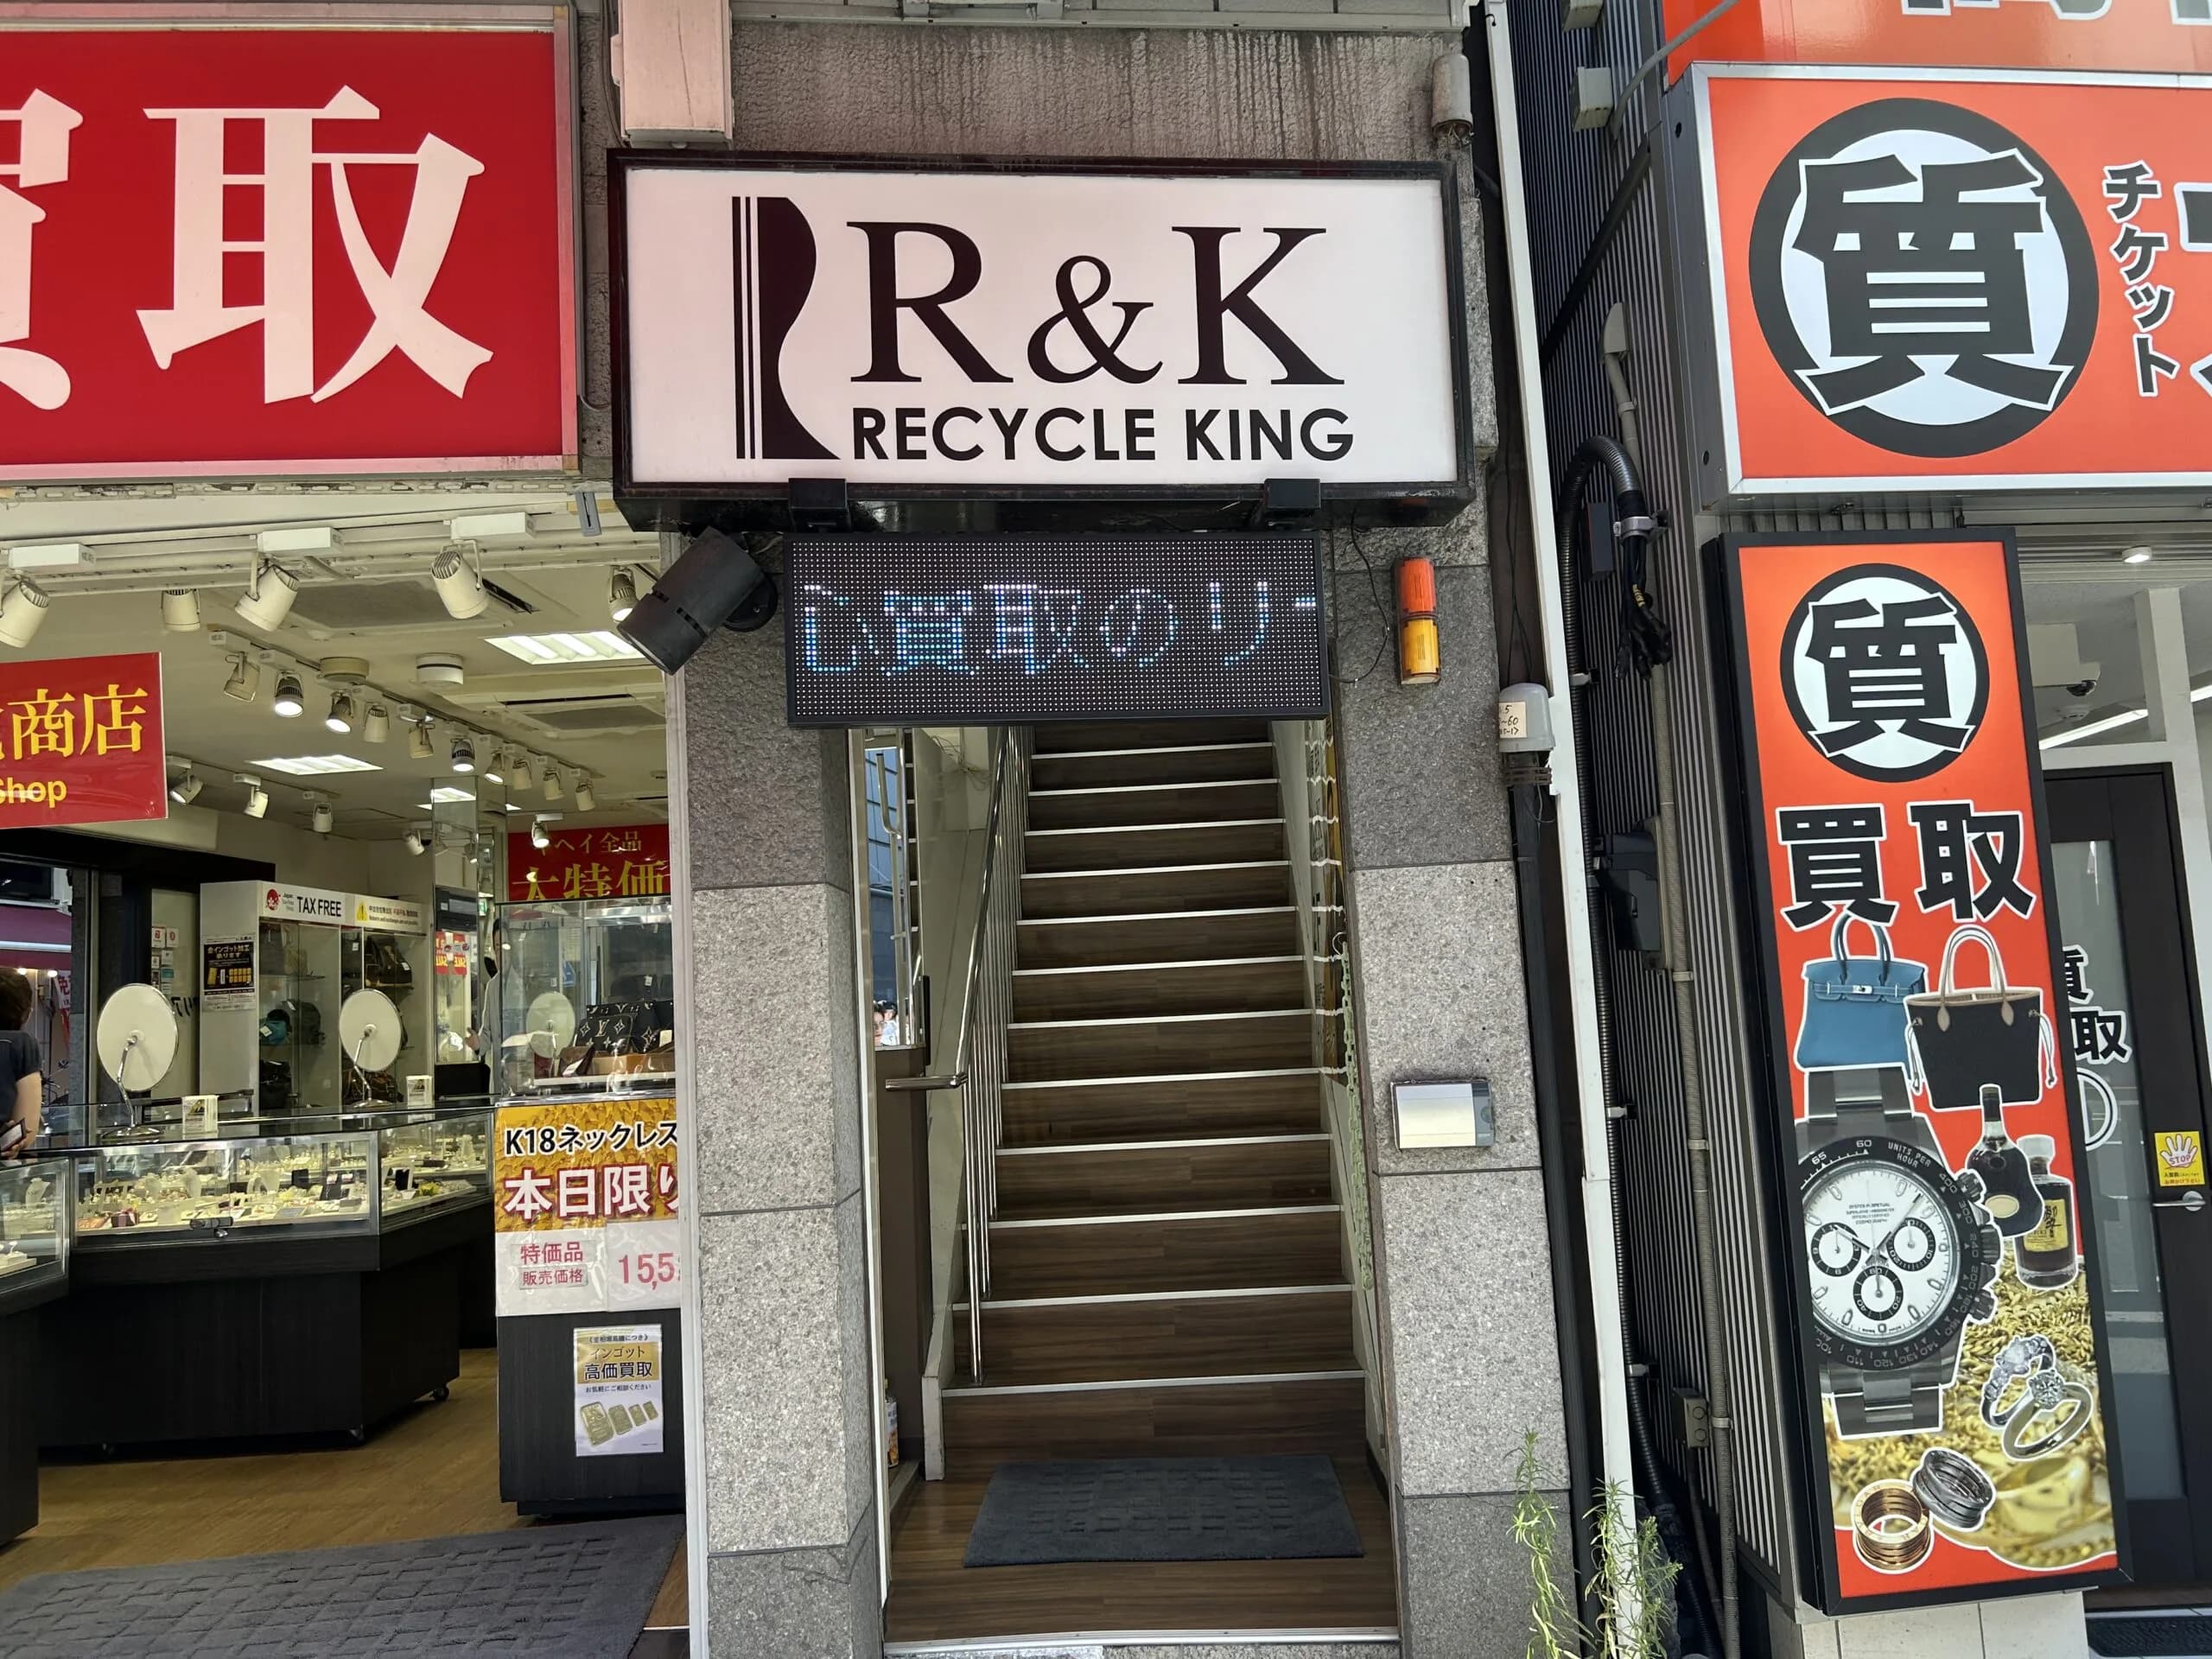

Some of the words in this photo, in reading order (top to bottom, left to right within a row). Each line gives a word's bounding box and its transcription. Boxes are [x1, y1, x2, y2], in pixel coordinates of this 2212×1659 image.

[0, 85, 493, 404] 取
[1792, 149, 2074, 416] 質
[2104, 161, 2178, 396] チケット
[846, 221, 1345, 385] R&K
[854, 406, 1156, 461] RECYCLE
[1186, 408, 1354, 462] KING
[1805, 592, 1976, 757] 質
[0, 683, 149, 760] 商店
[541, 830, 642, 856] ヘイ全品
[1776, 799, 2037, 931] 買取
[297, 896, 316, 915] TAX
[317, 901, 342, 917] FREE
[505, 1122, 677, 1155] K18ネックレス
[1888, 1141, 1913, 1155] UNITS
[1916, 1153, 1932, 1167] PER
[1897, 1153, 1919, 1168] HOUR
[2169, 1154, 2191, 1165] STOP
[520, 1241, 584, 1264] 特価品
[523, 1270, 583, 1286] 販売価格
[619, 1253, 681, 1290] 15,5
[591, 1345, 645, 1360] インゴット
[585, 1362, 653, 1381] 高価買取
